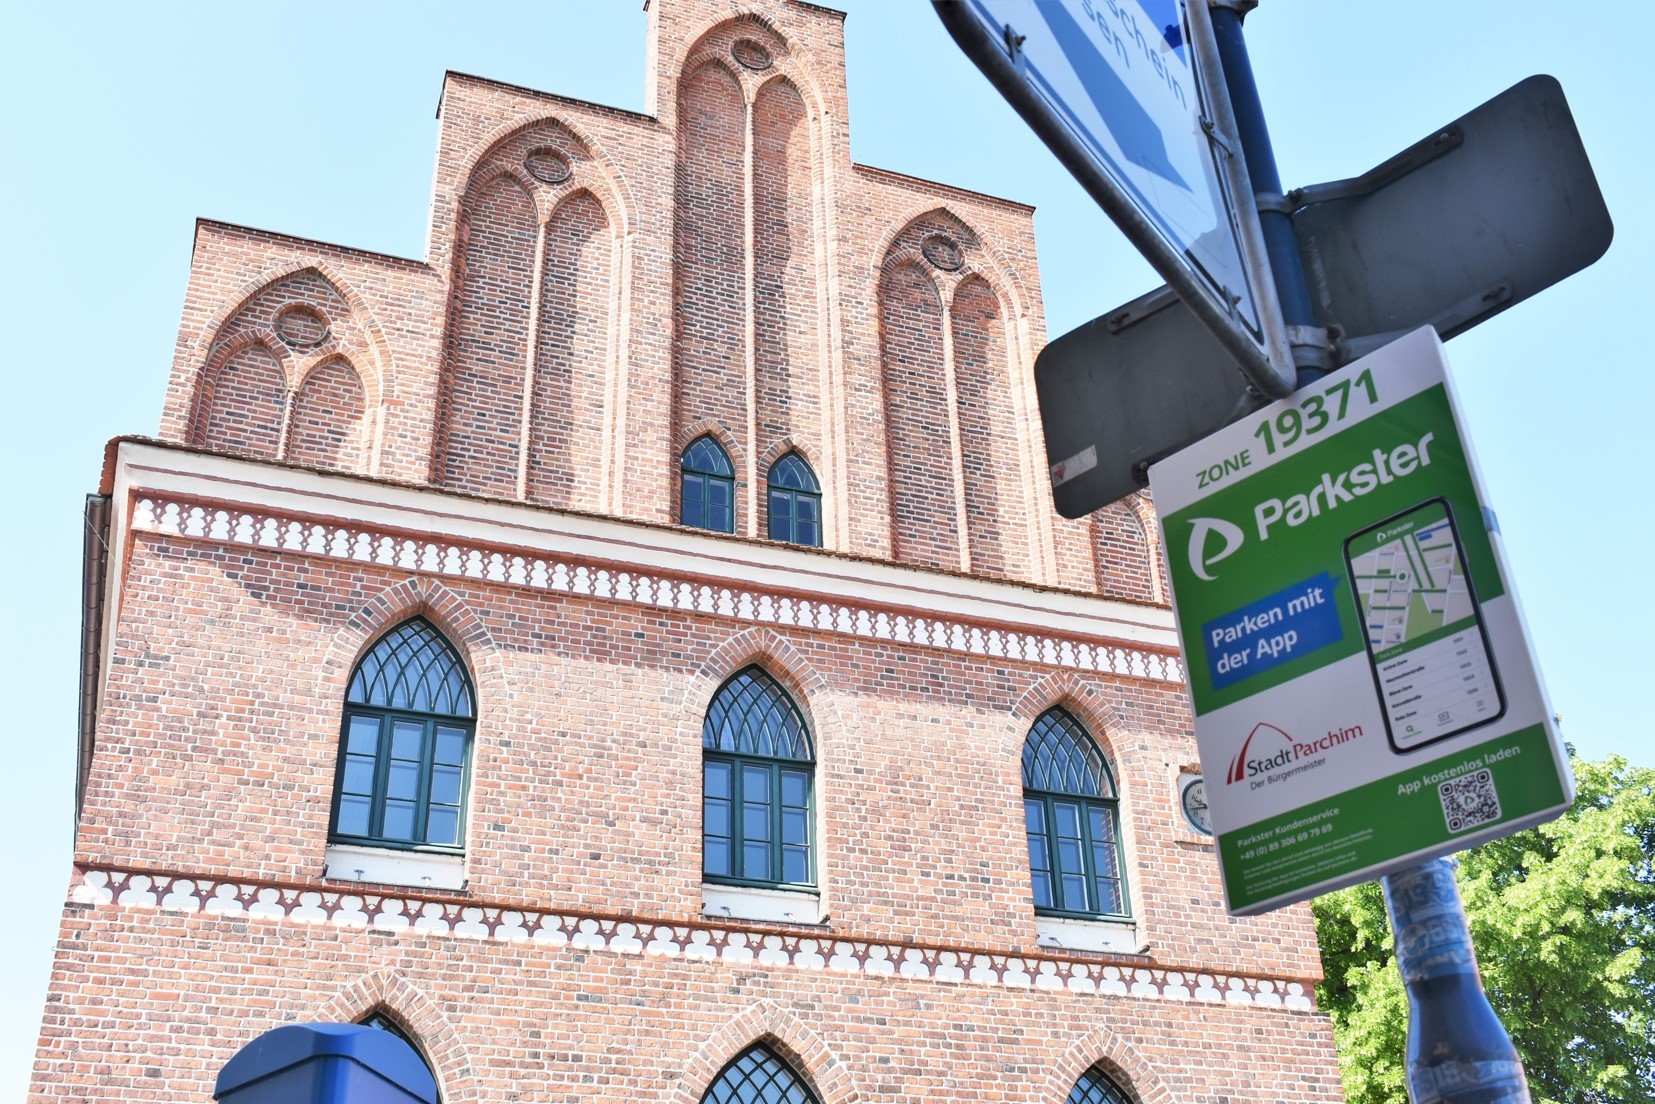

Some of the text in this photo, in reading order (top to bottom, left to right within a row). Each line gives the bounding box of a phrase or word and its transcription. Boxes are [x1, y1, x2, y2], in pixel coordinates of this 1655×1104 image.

[1195, 368, 1379, 489] ZONE 19371
[1254, 432, 1435, 541] Parkster
[1210, 586, 1325, 648] Parken mit
[1216, 630, 1298, 674] der App
[1247, 725, 1363, 777] Stadt Parchim
[1250, 757, 1326, 790] Der Bürgermeister
[1397, 745, 1521, 796] App kostenlos laden
[1237, 808, 1340, 848] Parkster Kundenservice
[1240, 823, 1333, 860] +49 (0) 89 306 69 79 69
